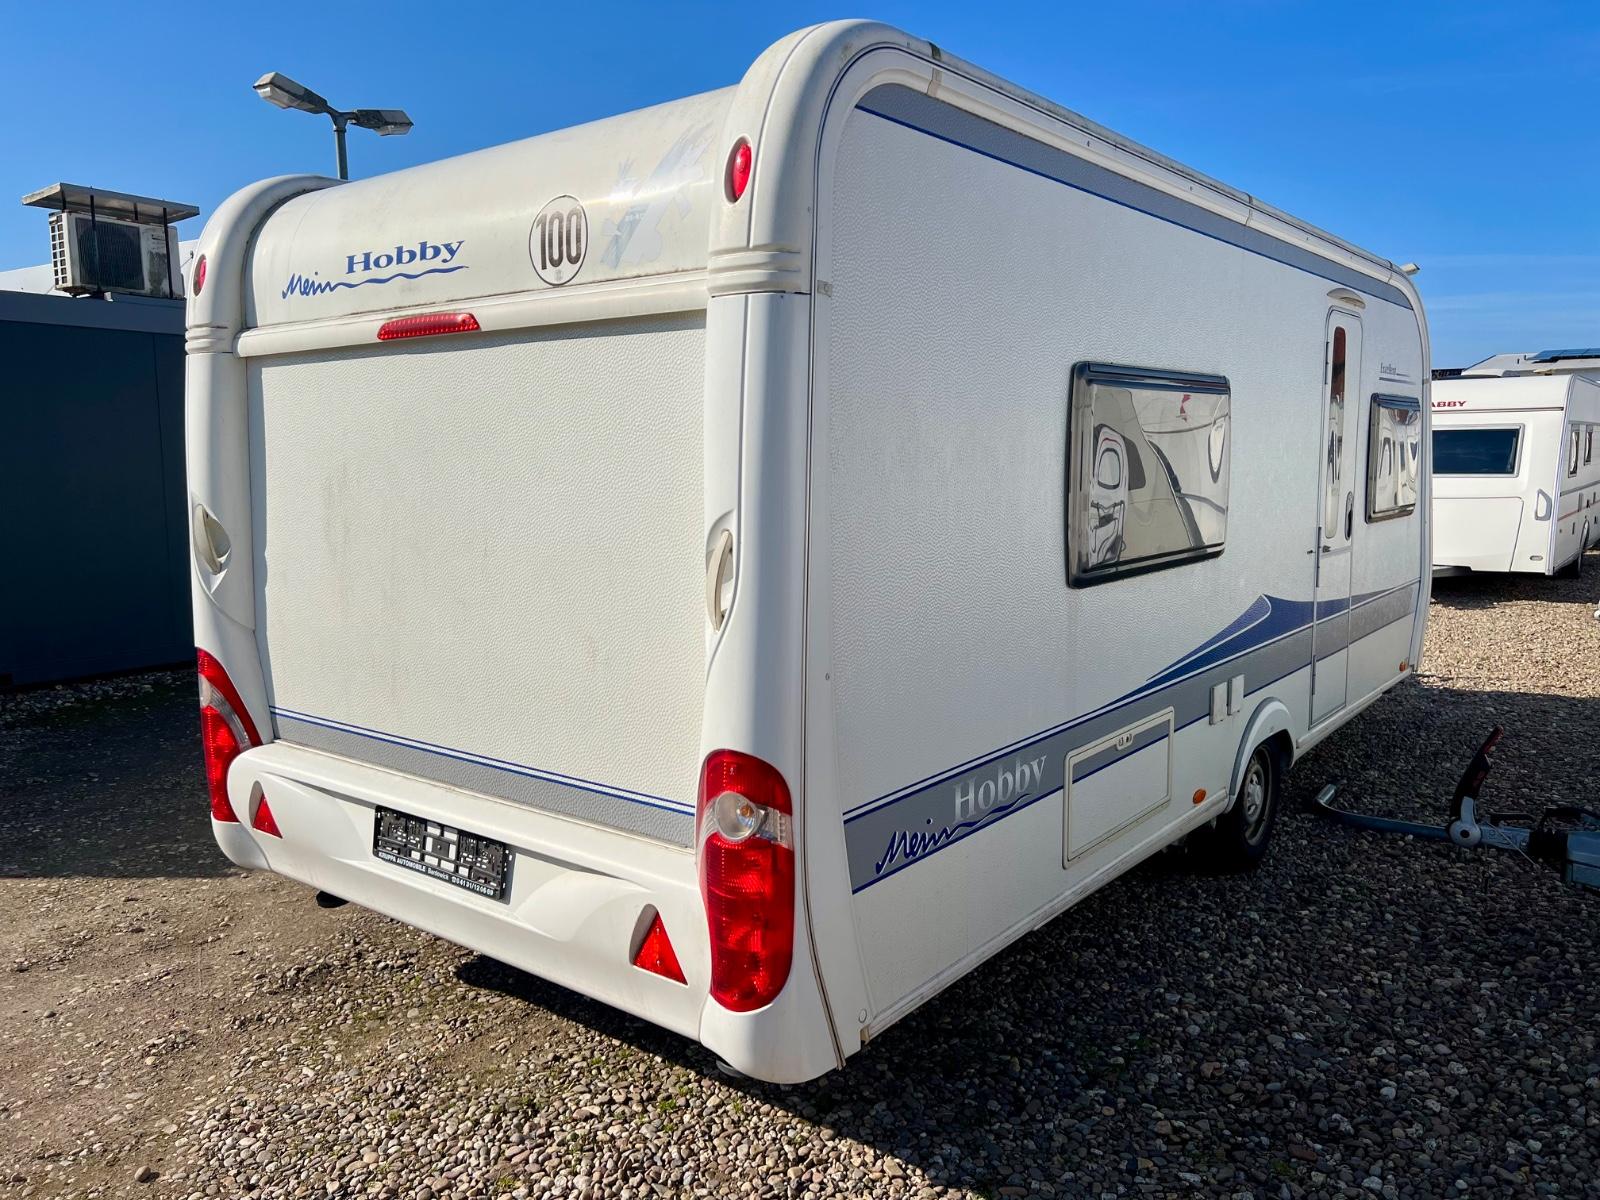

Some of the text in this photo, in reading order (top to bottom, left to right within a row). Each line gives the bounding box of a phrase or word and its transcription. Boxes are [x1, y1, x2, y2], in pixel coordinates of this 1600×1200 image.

[282, 239, 465, 299] Mein Hobby
[536, 207, 583, 271] 100
[875, 753, 1048, 874] Mein Hobby
[396, 857, 426, 872] AUTOMOBILE
